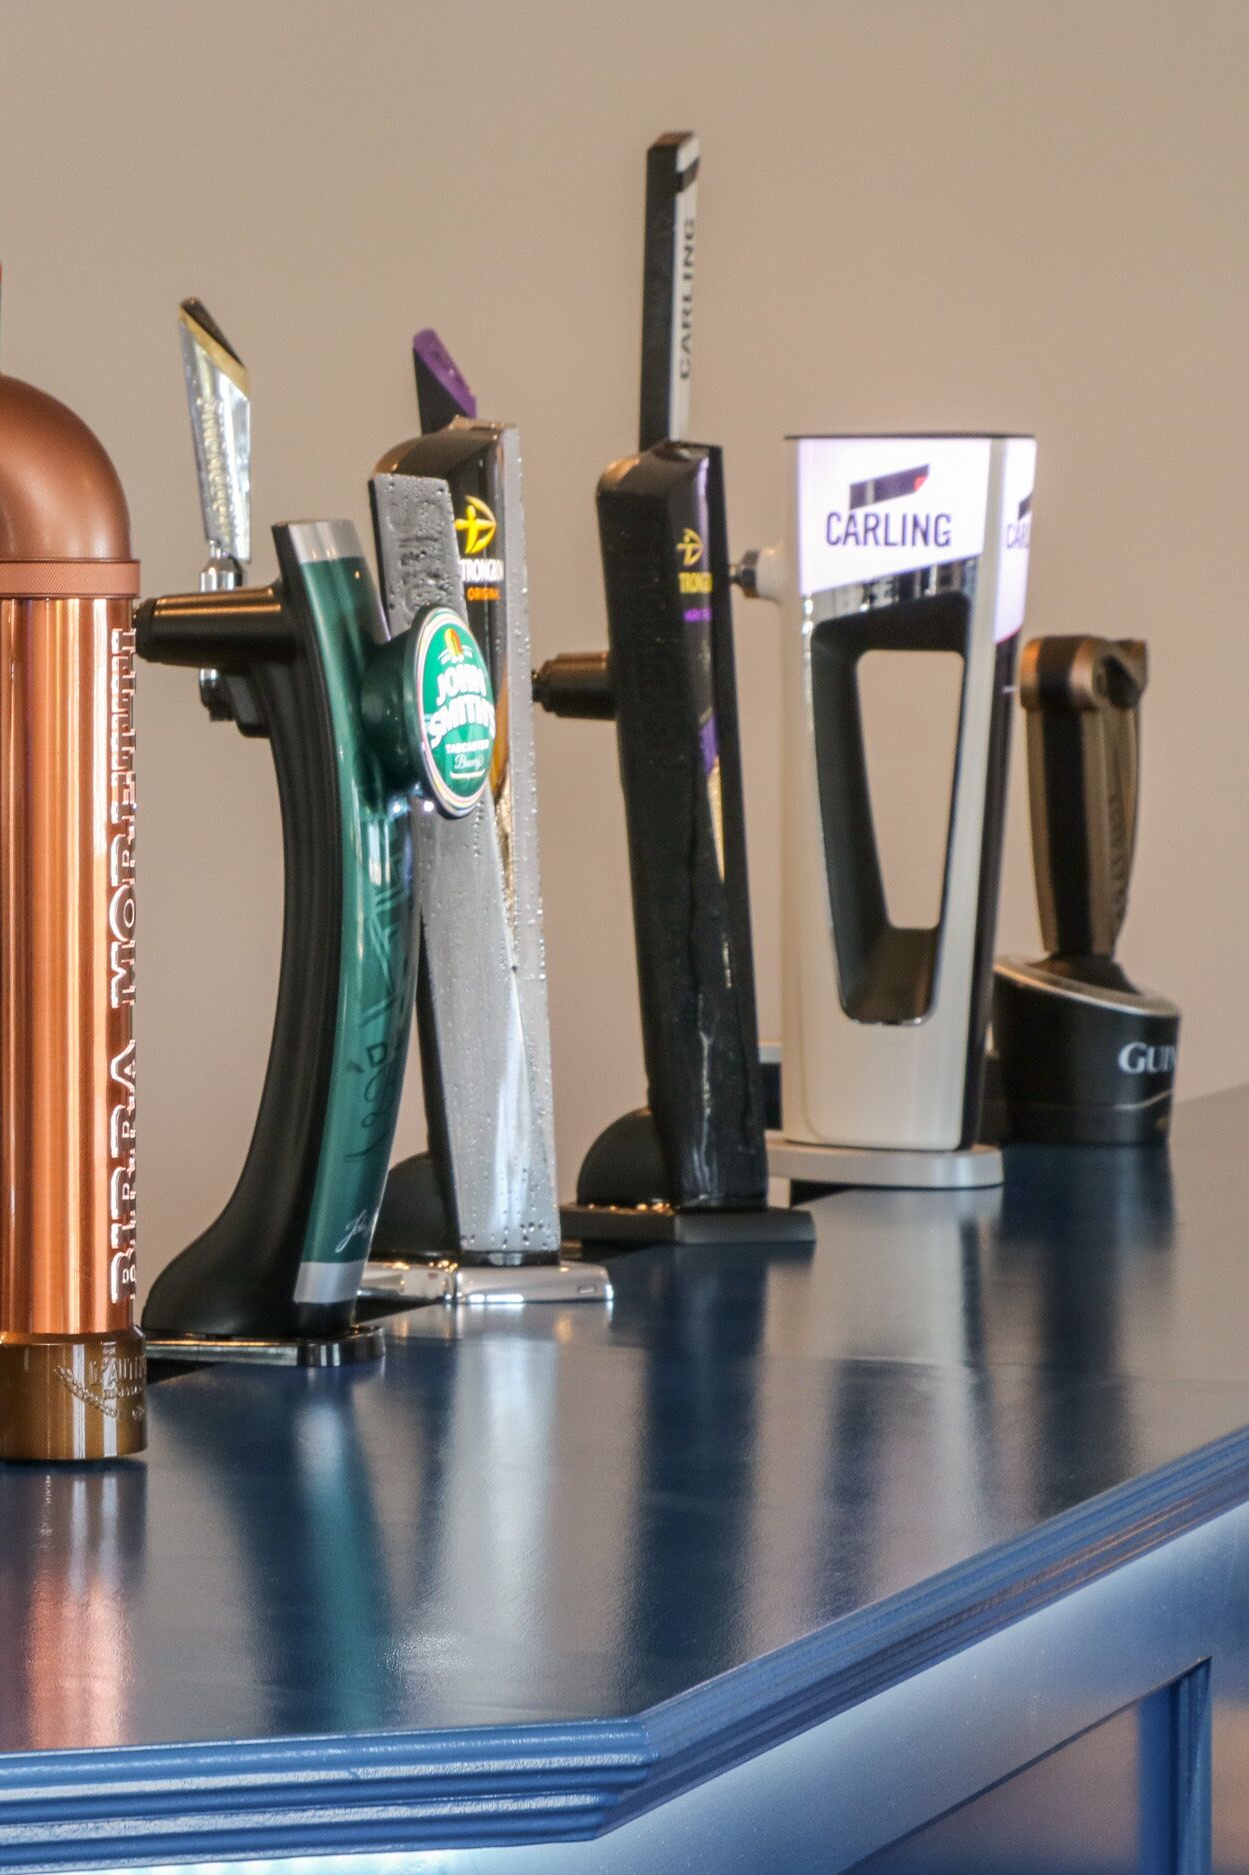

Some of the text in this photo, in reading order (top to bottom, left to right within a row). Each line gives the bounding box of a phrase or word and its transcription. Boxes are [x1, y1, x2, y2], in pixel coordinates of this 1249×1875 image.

[679, 217, 696, 379] CARLING
[826, 512, 951, 547] CARLING
[436, 663, 487, 706] JOHN
